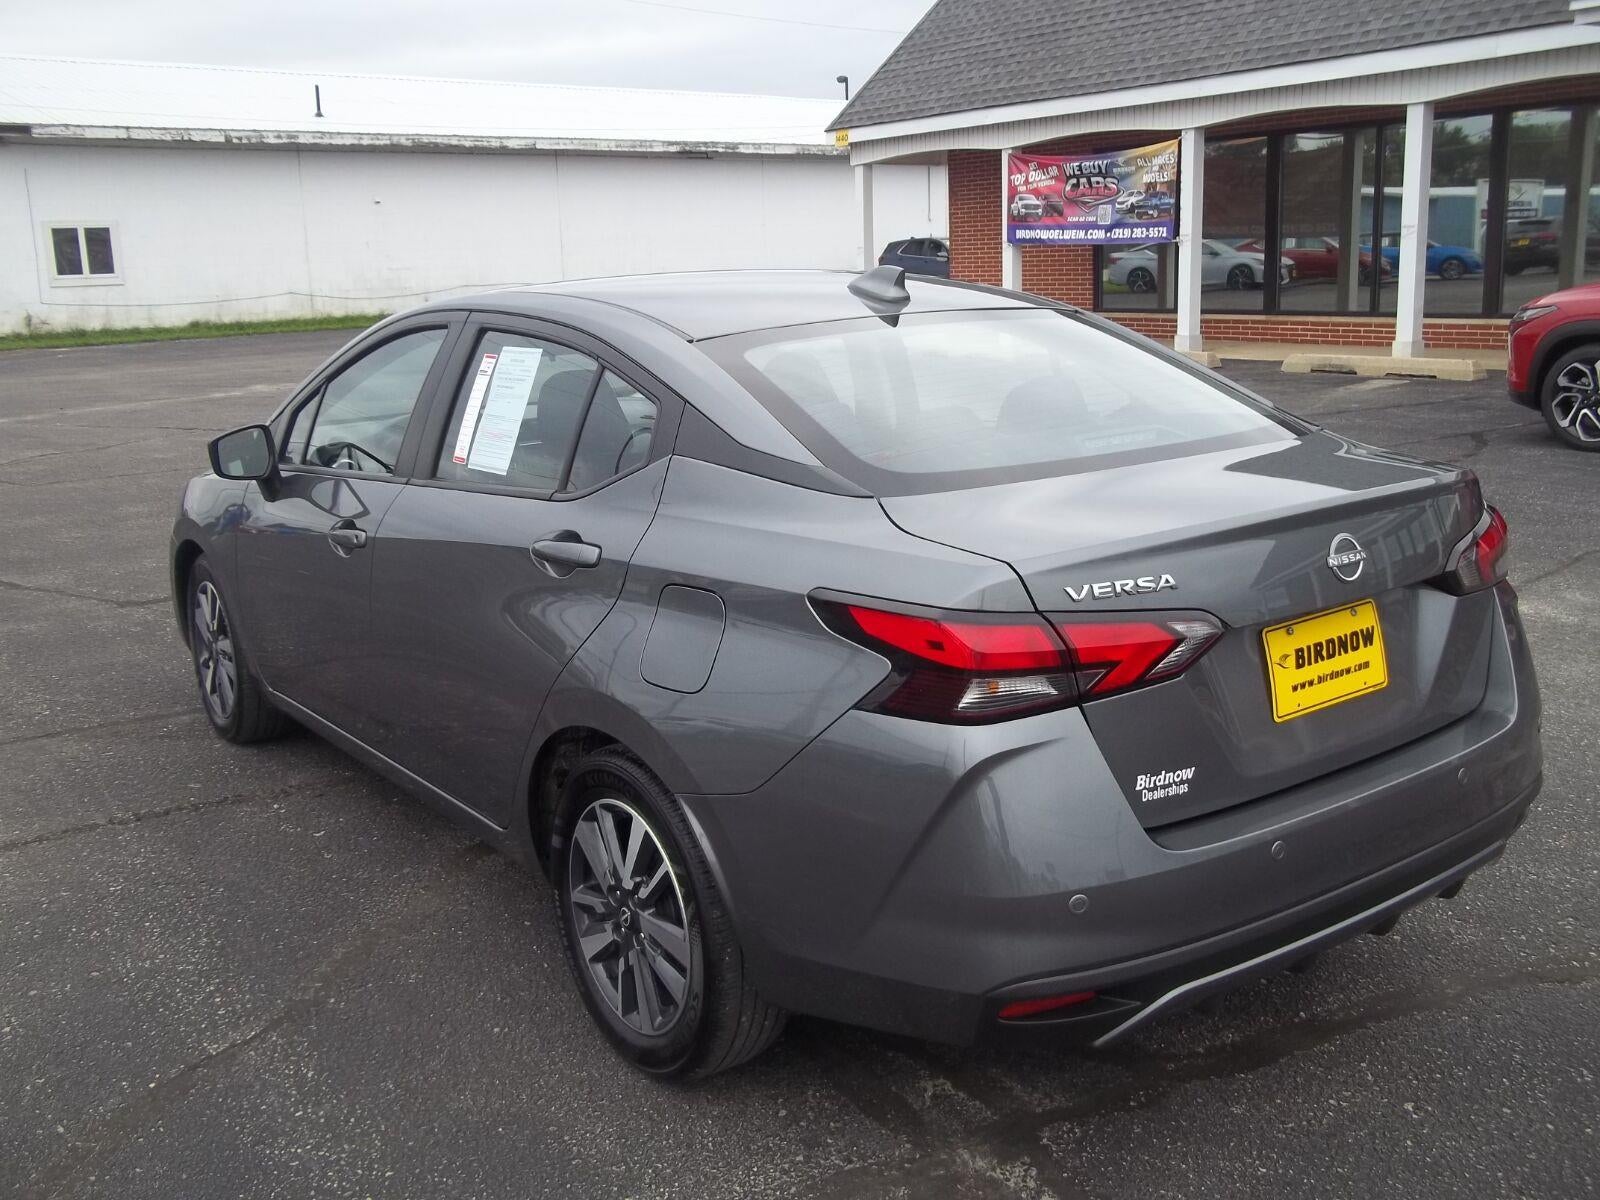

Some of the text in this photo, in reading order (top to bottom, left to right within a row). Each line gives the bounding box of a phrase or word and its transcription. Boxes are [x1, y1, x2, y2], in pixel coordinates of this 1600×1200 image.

[1063, 160, 1108, 177] WE BUY
[1137, 153, 1174, 167] ALL MAKES
[1010, 165, 1059, 187] TOP DOLLAR
[1065, 176, 1118, 198] CARS
[1015, 226, 1167, 240] BIRDNOWOELWEIN.COM (319) 283-5571
[1328, 552, 1368, 567] NISSAN
[1063, 574, 1177, 602] VERSA
[1294, 625, 1375, 670] BIRDNOW
[1291, 660, 1370, 693] www.birdnow.com
[1135, 766, 1196, 791] Birdnow
[1142, 783, 1189, 802] Dealerships
